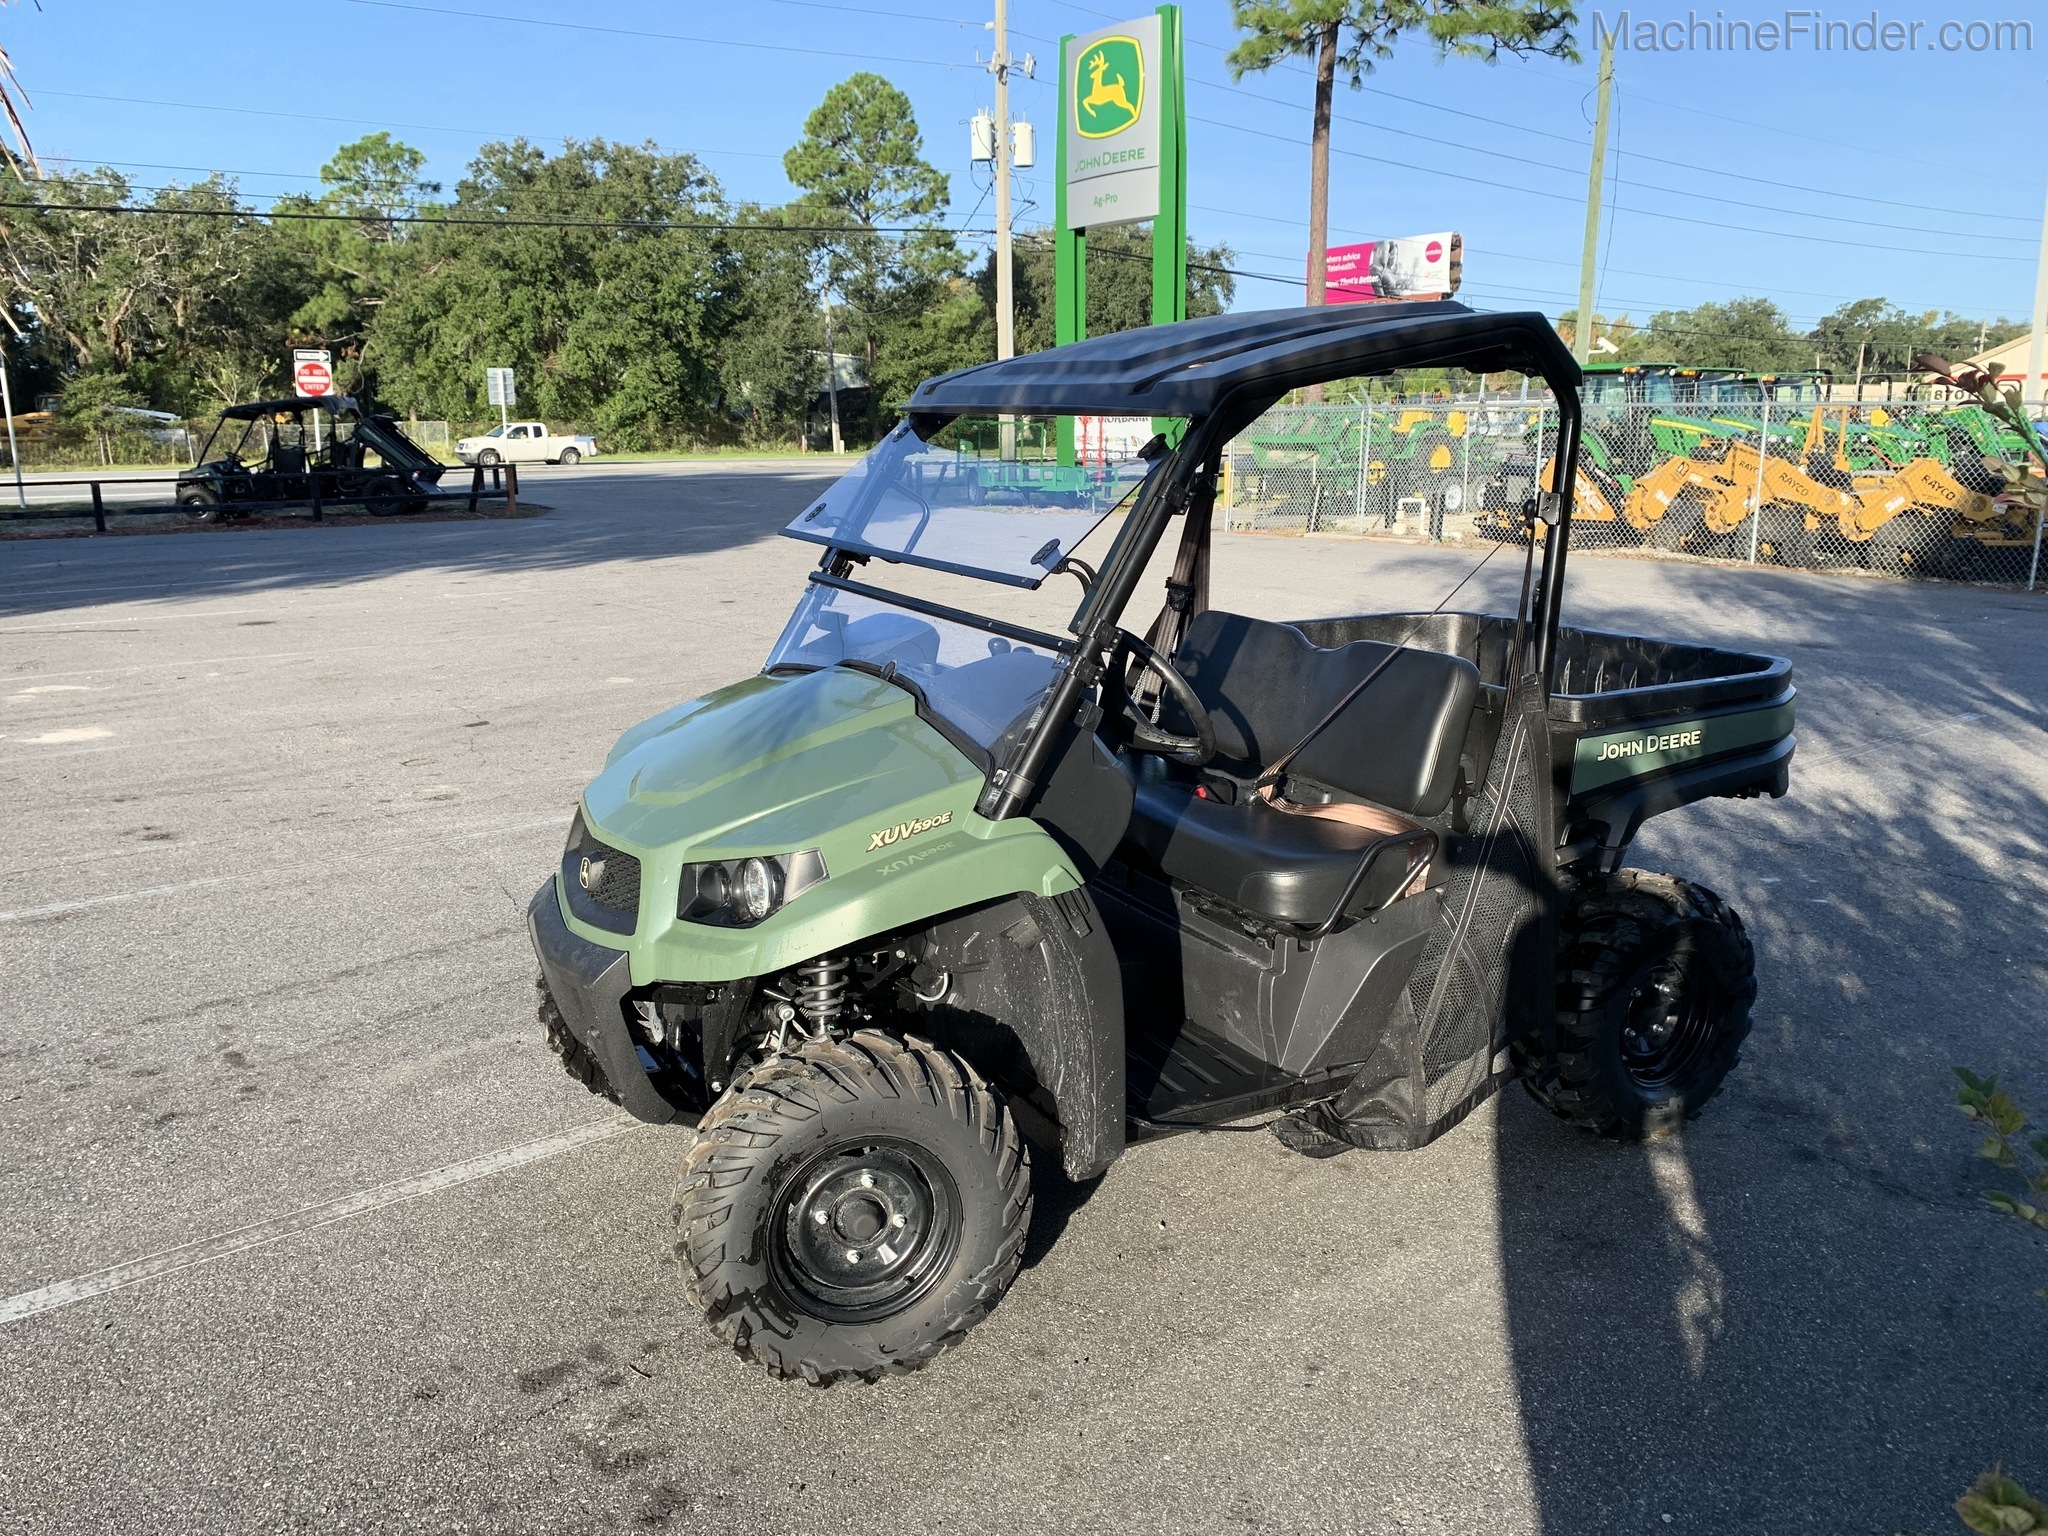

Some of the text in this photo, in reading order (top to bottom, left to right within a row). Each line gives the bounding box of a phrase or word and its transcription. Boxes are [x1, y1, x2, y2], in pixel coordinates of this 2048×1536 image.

[1075, 148, 1146, 173] JOHN DEERE
[1094, 193, 1118, 208] Ag-Pro
[300, 369, 326, 377] DO NOT
[303, 383, 325, 392] ENTER
[1738, 459, 1759, 474] RAYC
[1778, 472, 1810, 498] RAYCO
[1921, 474, 1956, 501] RAYCO
[1597, 729, 1702, 762] JOHN DEERE
[865, 811, 953, 853] XUV590E
